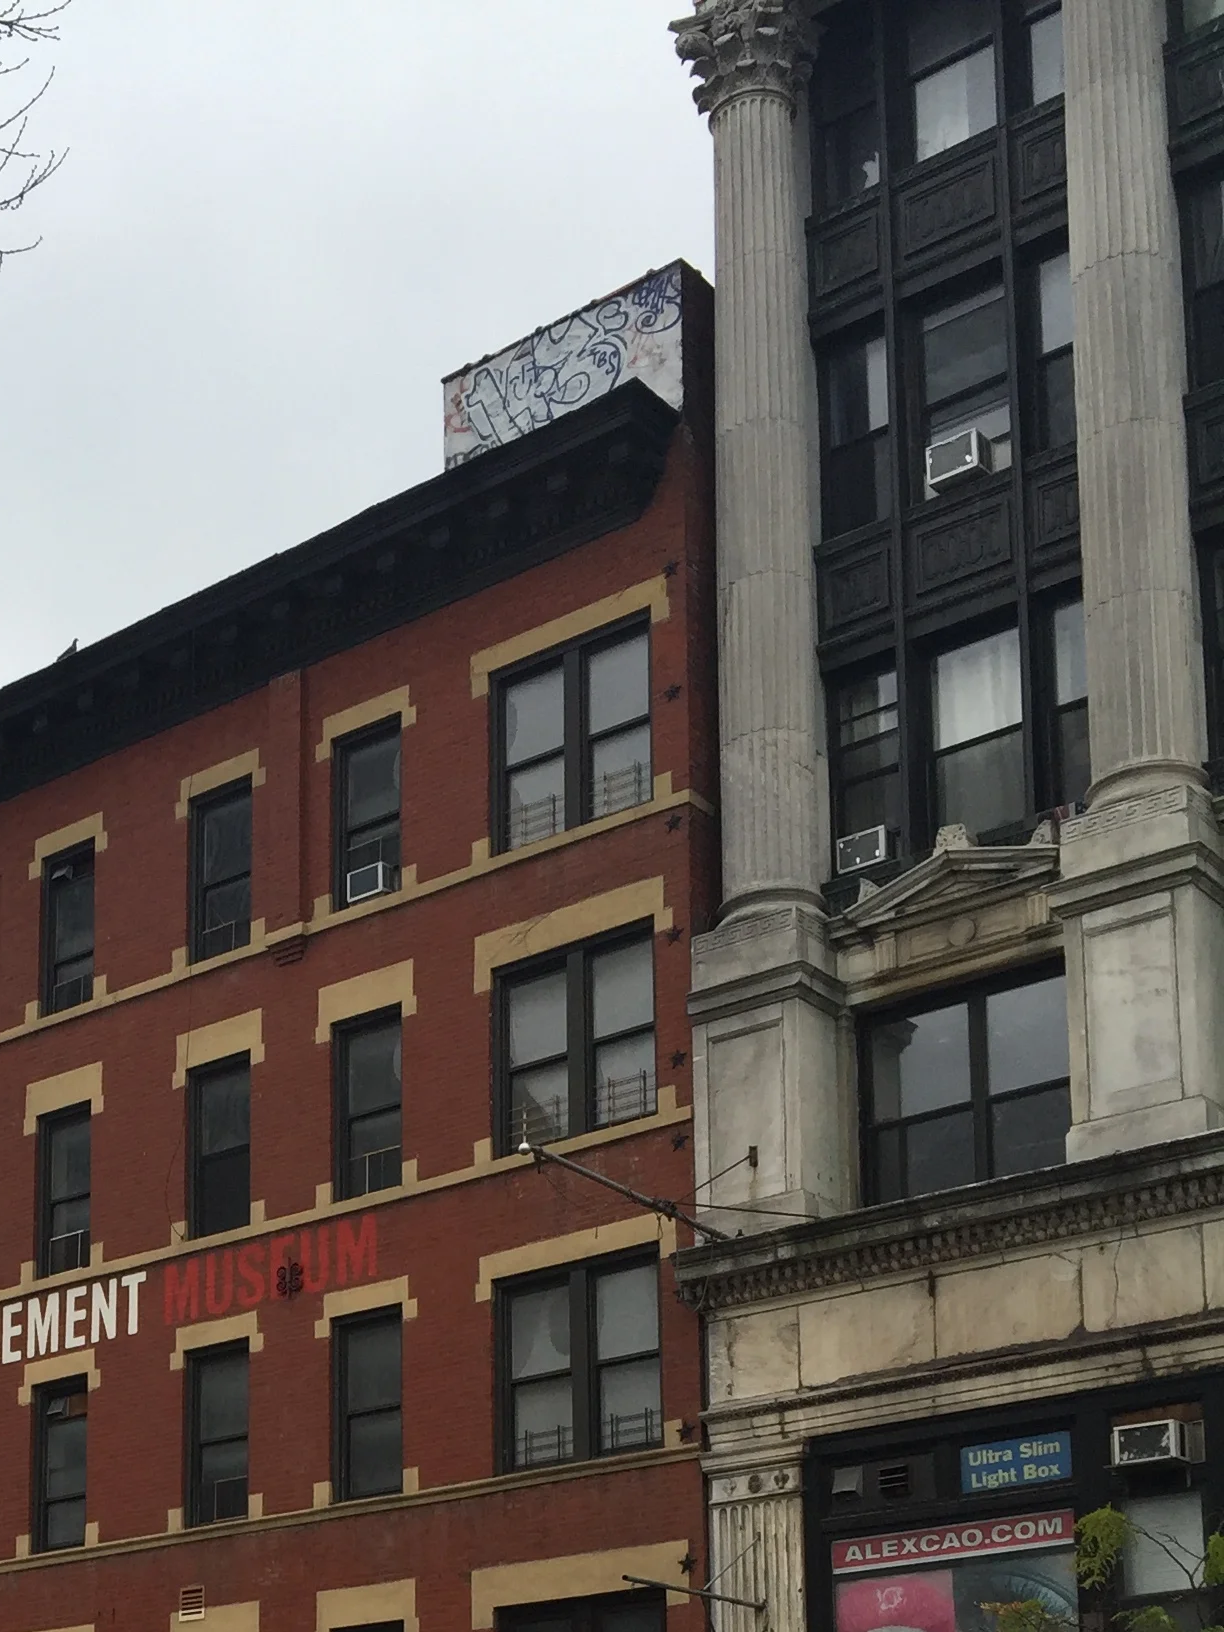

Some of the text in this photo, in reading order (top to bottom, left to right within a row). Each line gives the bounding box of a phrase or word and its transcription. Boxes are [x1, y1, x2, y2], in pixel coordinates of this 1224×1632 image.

[163, 1213, 378, 1326] MUSEUM
[968, 1439, 1061, 1467] Ultra Slim
[971, 1462, 1061, 1489] Light Box
[844, 1516, 1064, 1563] ALEXCAO.COM
